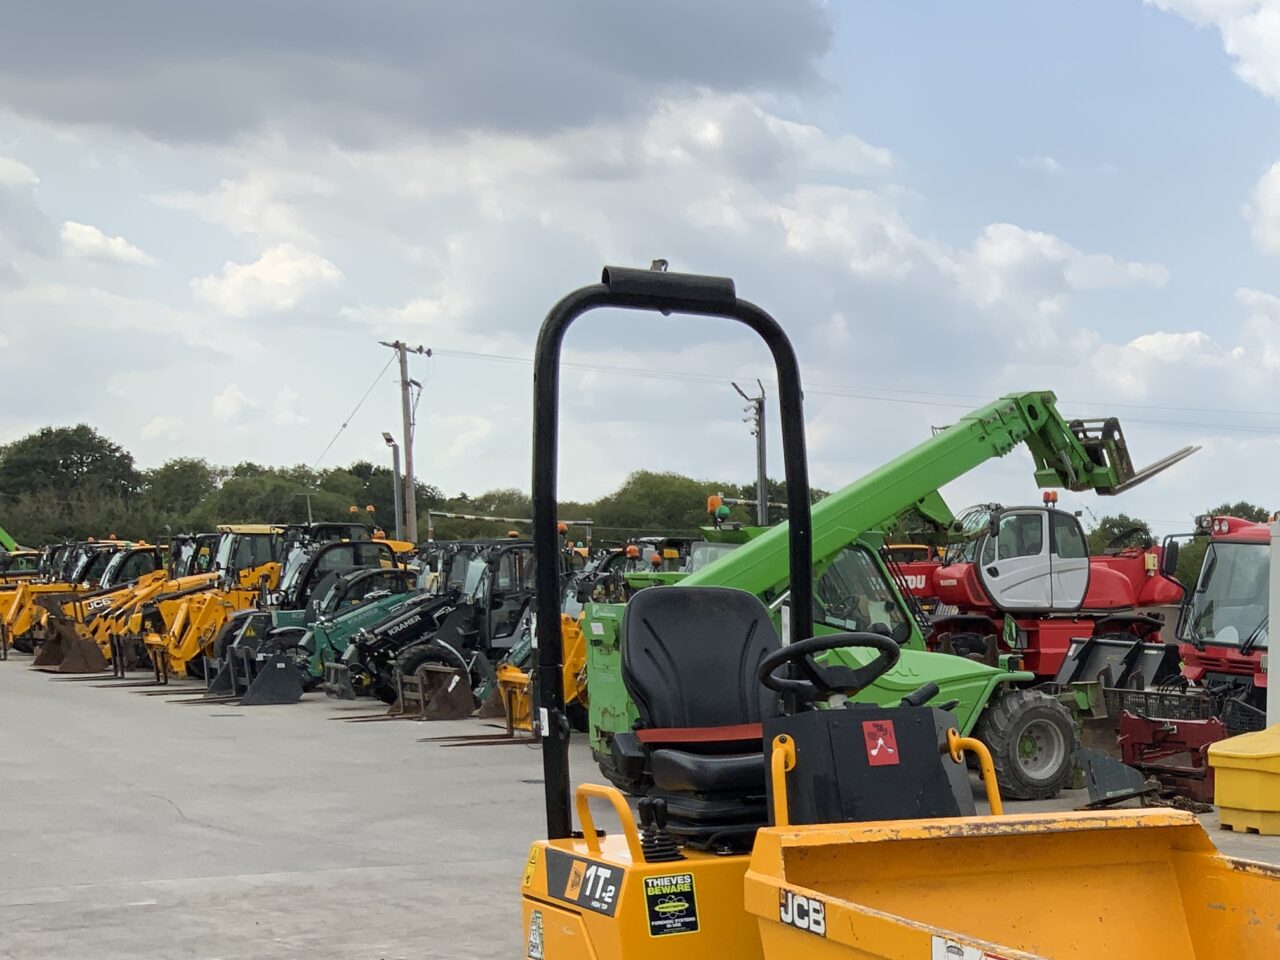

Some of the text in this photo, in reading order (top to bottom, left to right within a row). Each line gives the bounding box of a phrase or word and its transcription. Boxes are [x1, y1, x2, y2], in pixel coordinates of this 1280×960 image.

[387, 614, 423, 637] KRAMER
[646, 874, 692, 887] THIEVES
[647, 884, 692, 896] BEWARE
[780, 892, 826, 934] JCB
